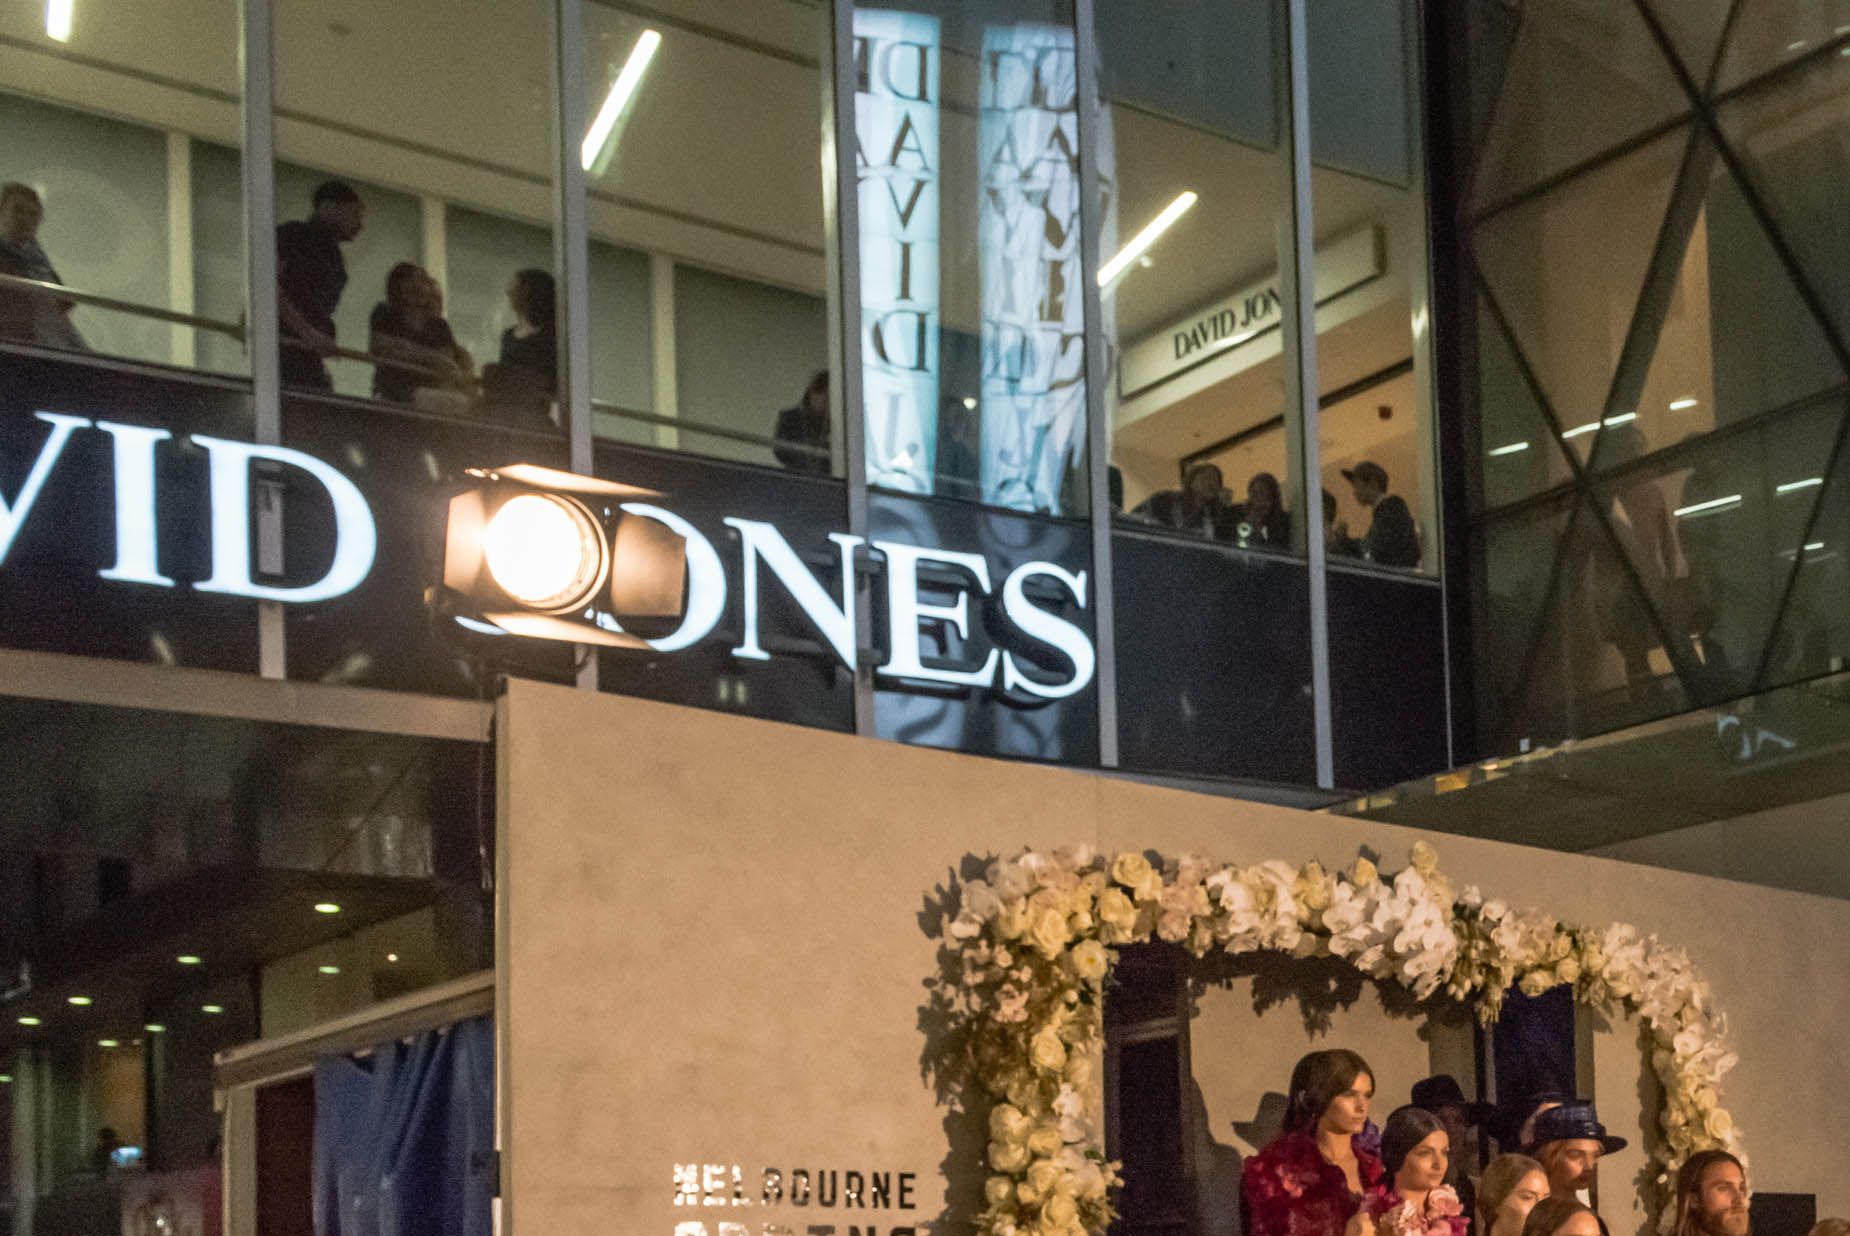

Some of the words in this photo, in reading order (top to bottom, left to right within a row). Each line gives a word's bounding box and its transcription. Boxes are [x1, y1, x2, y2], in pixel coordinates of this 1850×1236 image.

[1172, 309, 1236, 361] DAVID
[455, 502, 1096, 699] ONES
[673, 1163, 917, 1210] MELBOURNE
